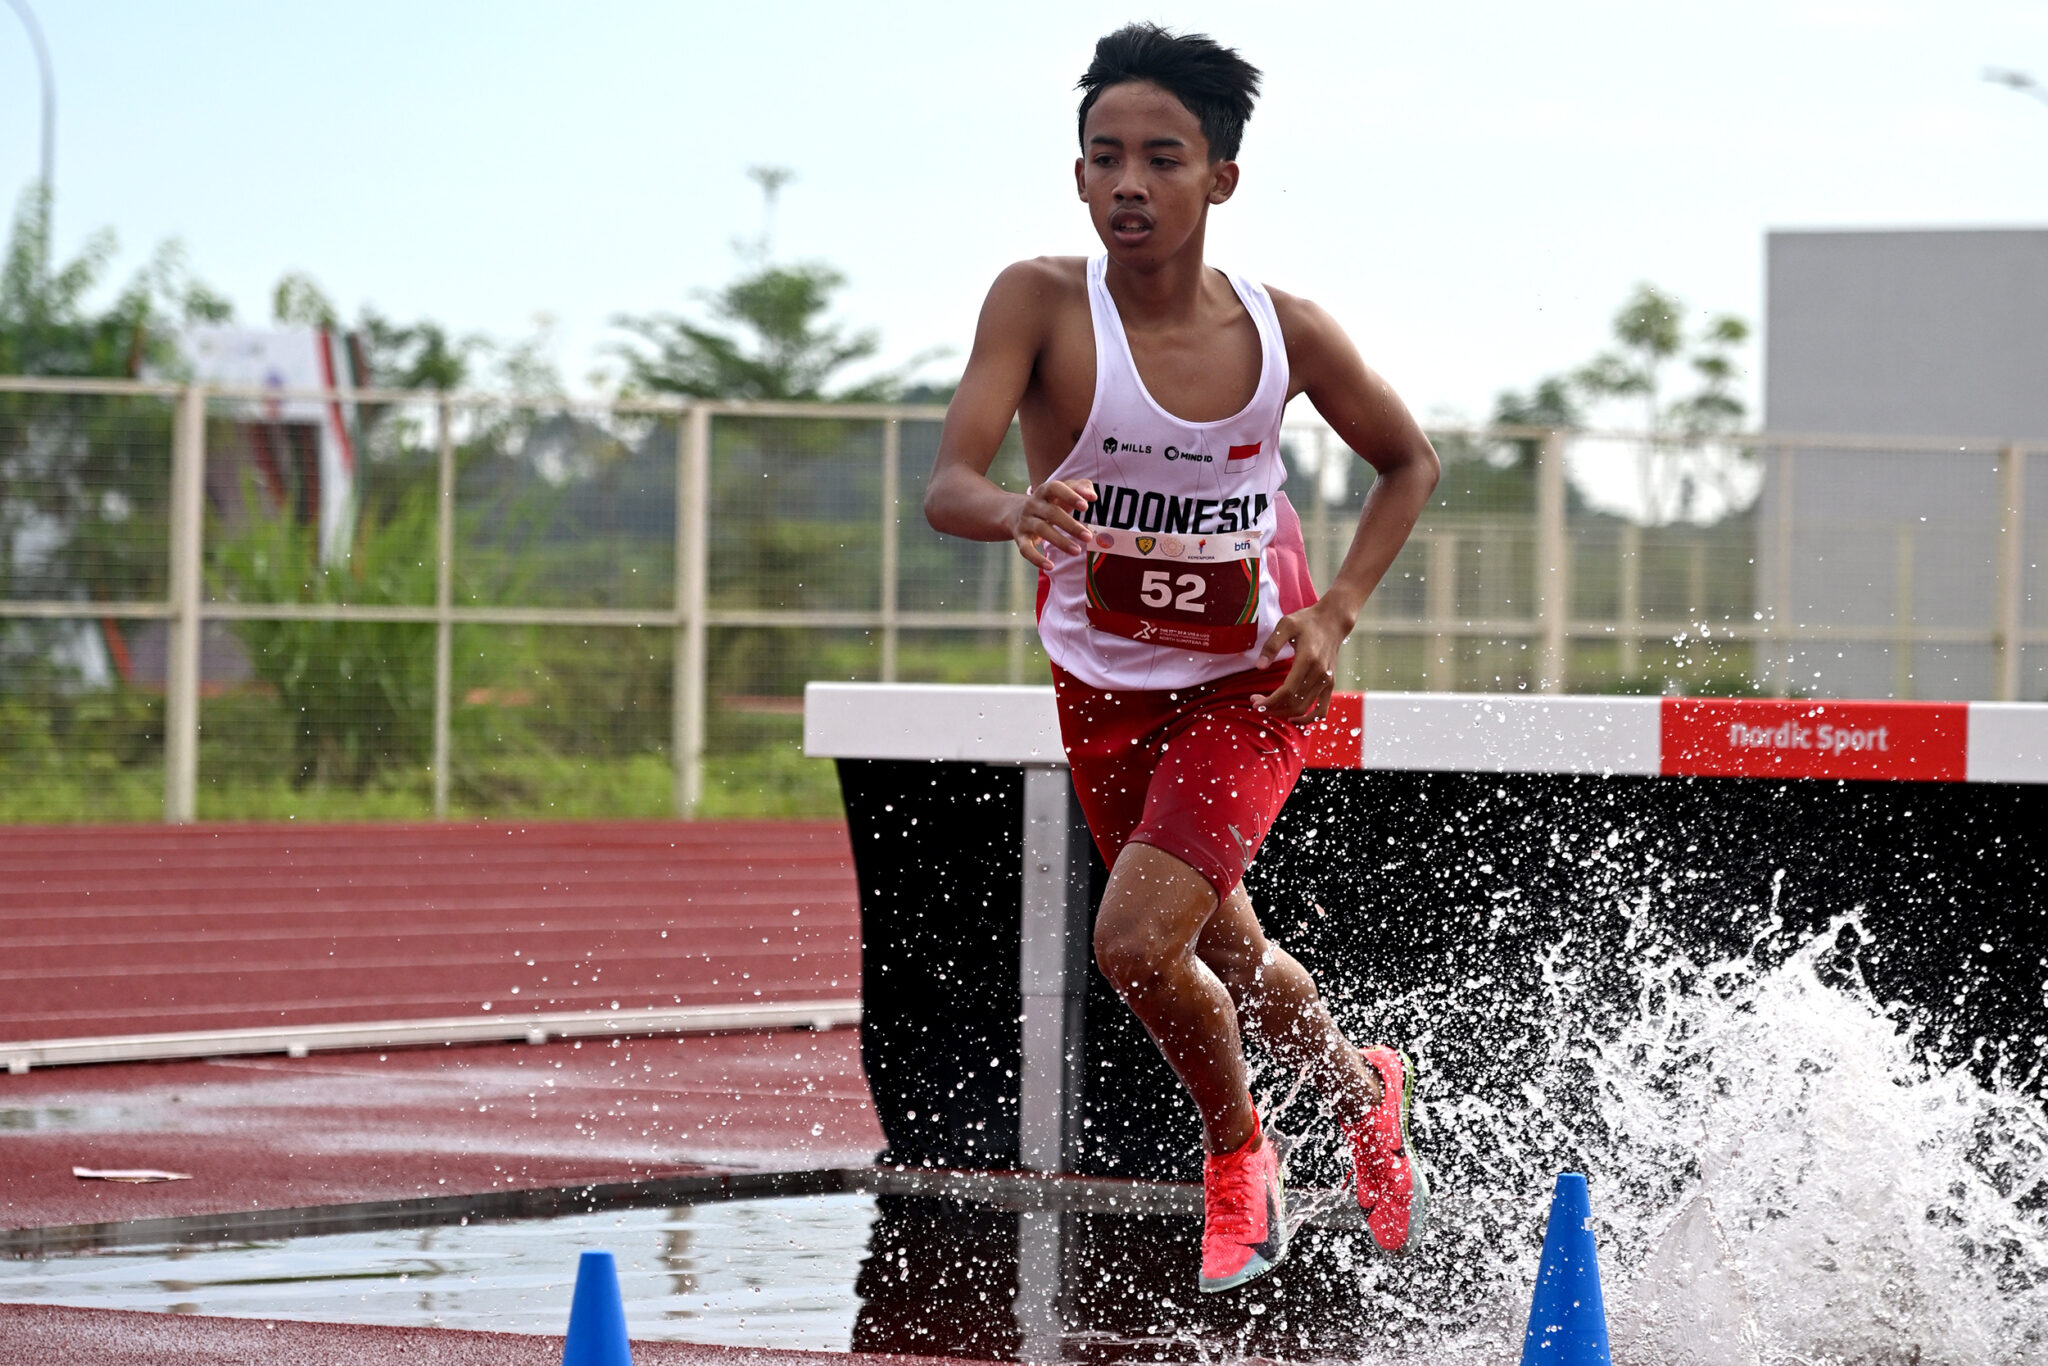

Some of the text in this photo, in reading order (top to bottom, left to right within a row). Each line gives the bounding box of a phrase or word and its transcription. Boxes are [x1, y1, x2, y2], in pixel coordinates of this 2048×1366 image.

[1121, 443, 1152, 454] MILLS
[1180, 452, 1213, 463] MIND ID
[1234, 540, 1251, 552] btn
[1140, 570, 1207, 613] 52
[1817, 724, 1888, 757] Sport
